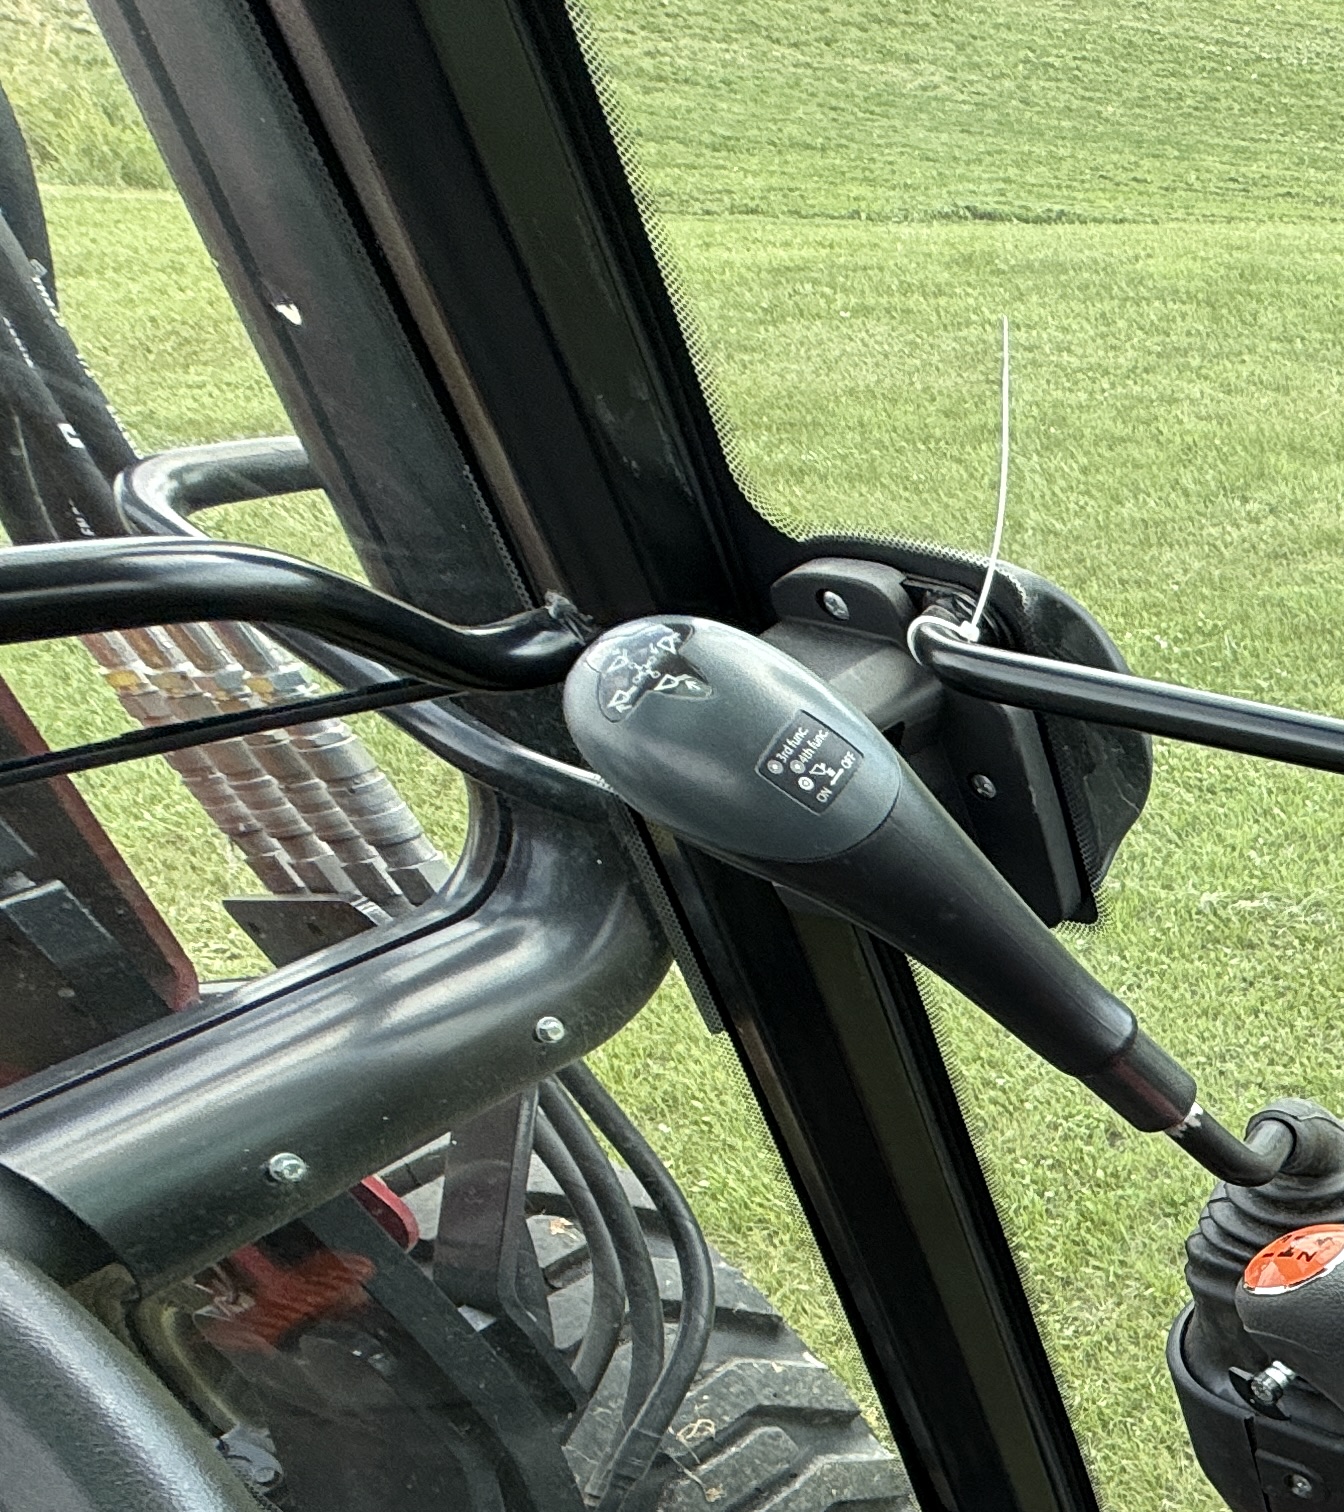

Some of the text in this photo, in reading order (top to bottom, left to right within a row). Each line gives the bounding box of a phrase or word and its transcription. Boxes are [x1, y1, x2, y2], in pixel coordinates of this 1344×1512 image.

[775, 727, 809, 763] 3rd func.
[798, 729, 829, 763] 4th func.
[840, 750, 856, 769] OFF
[816, 786, 832, 803] ON
